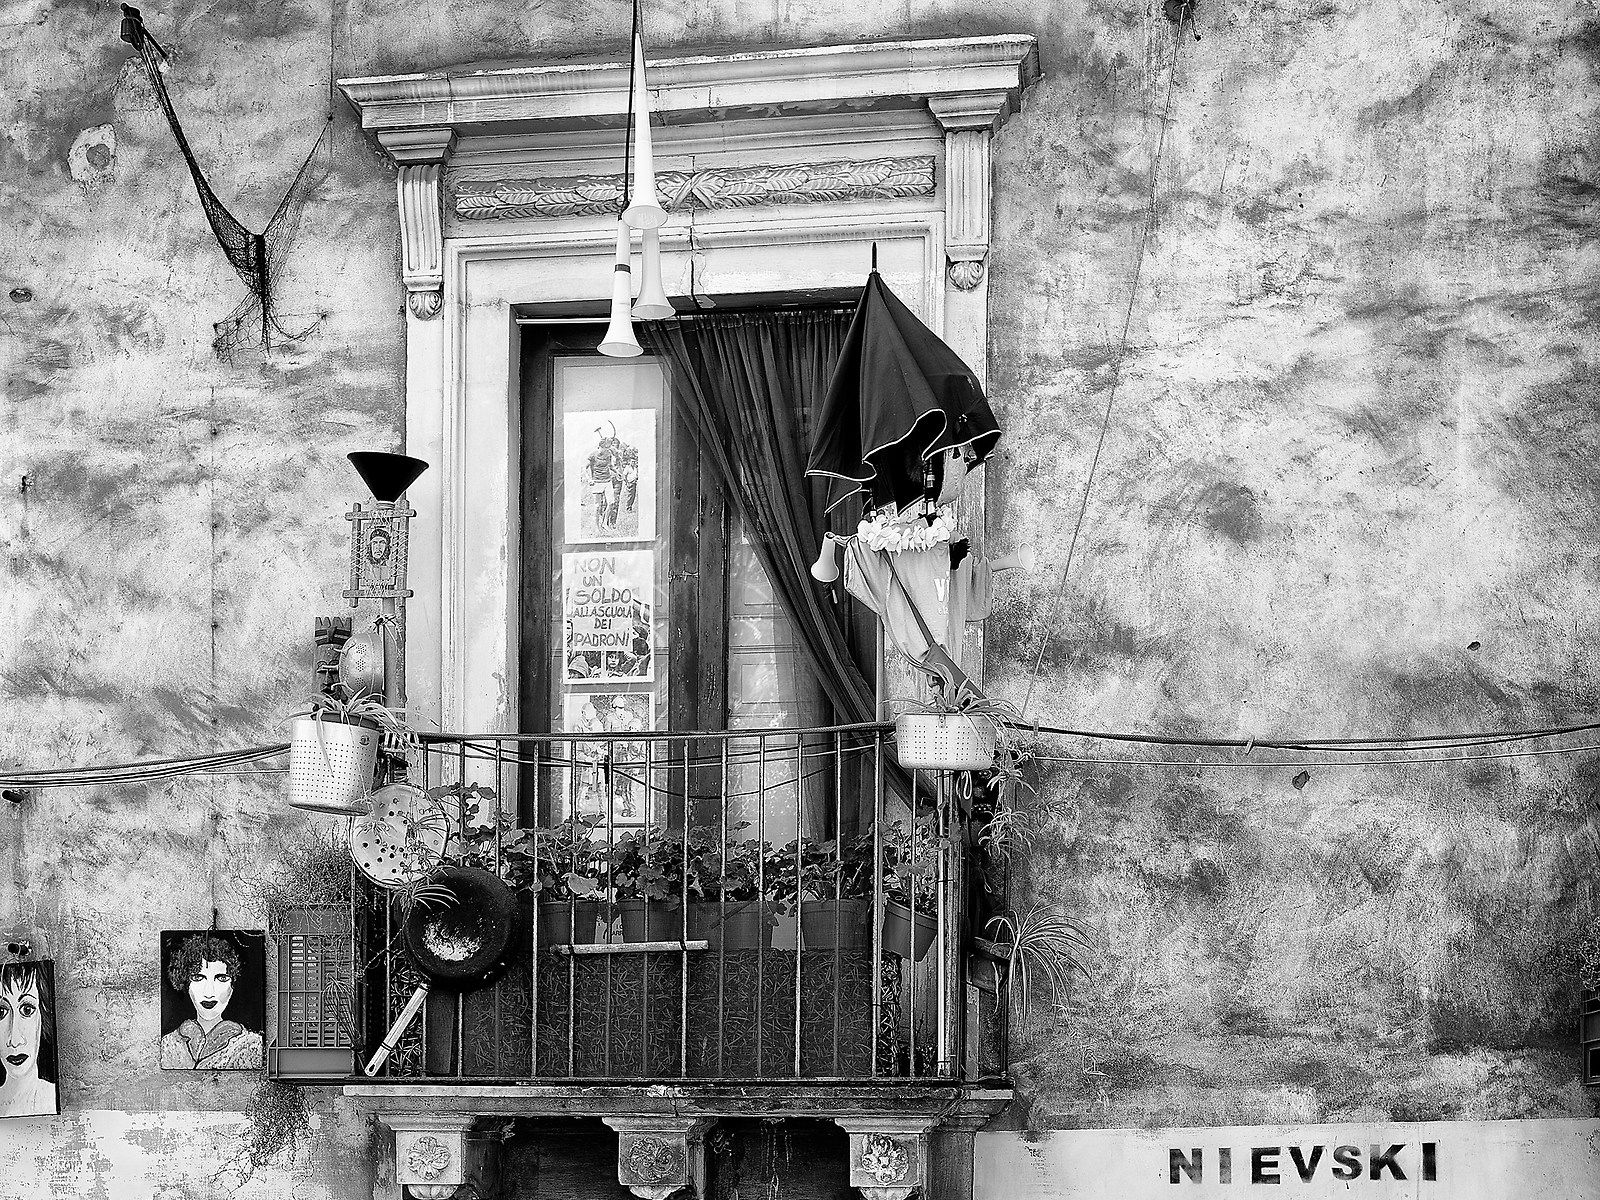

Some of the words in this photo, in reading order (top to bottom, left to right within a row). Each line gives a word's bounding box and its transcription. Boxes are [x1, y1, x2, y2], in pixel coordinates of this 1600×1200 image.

[574, 557, 615, 575] NON
[582, 575, 602, 587] UN
[573, 587, 631, 605] SOLDO
[594, 618, 611, 629] DEI
[574, 628, 630, 647] PADRONI
[1169, 1142, 1437, 1185] NIEVSKI
